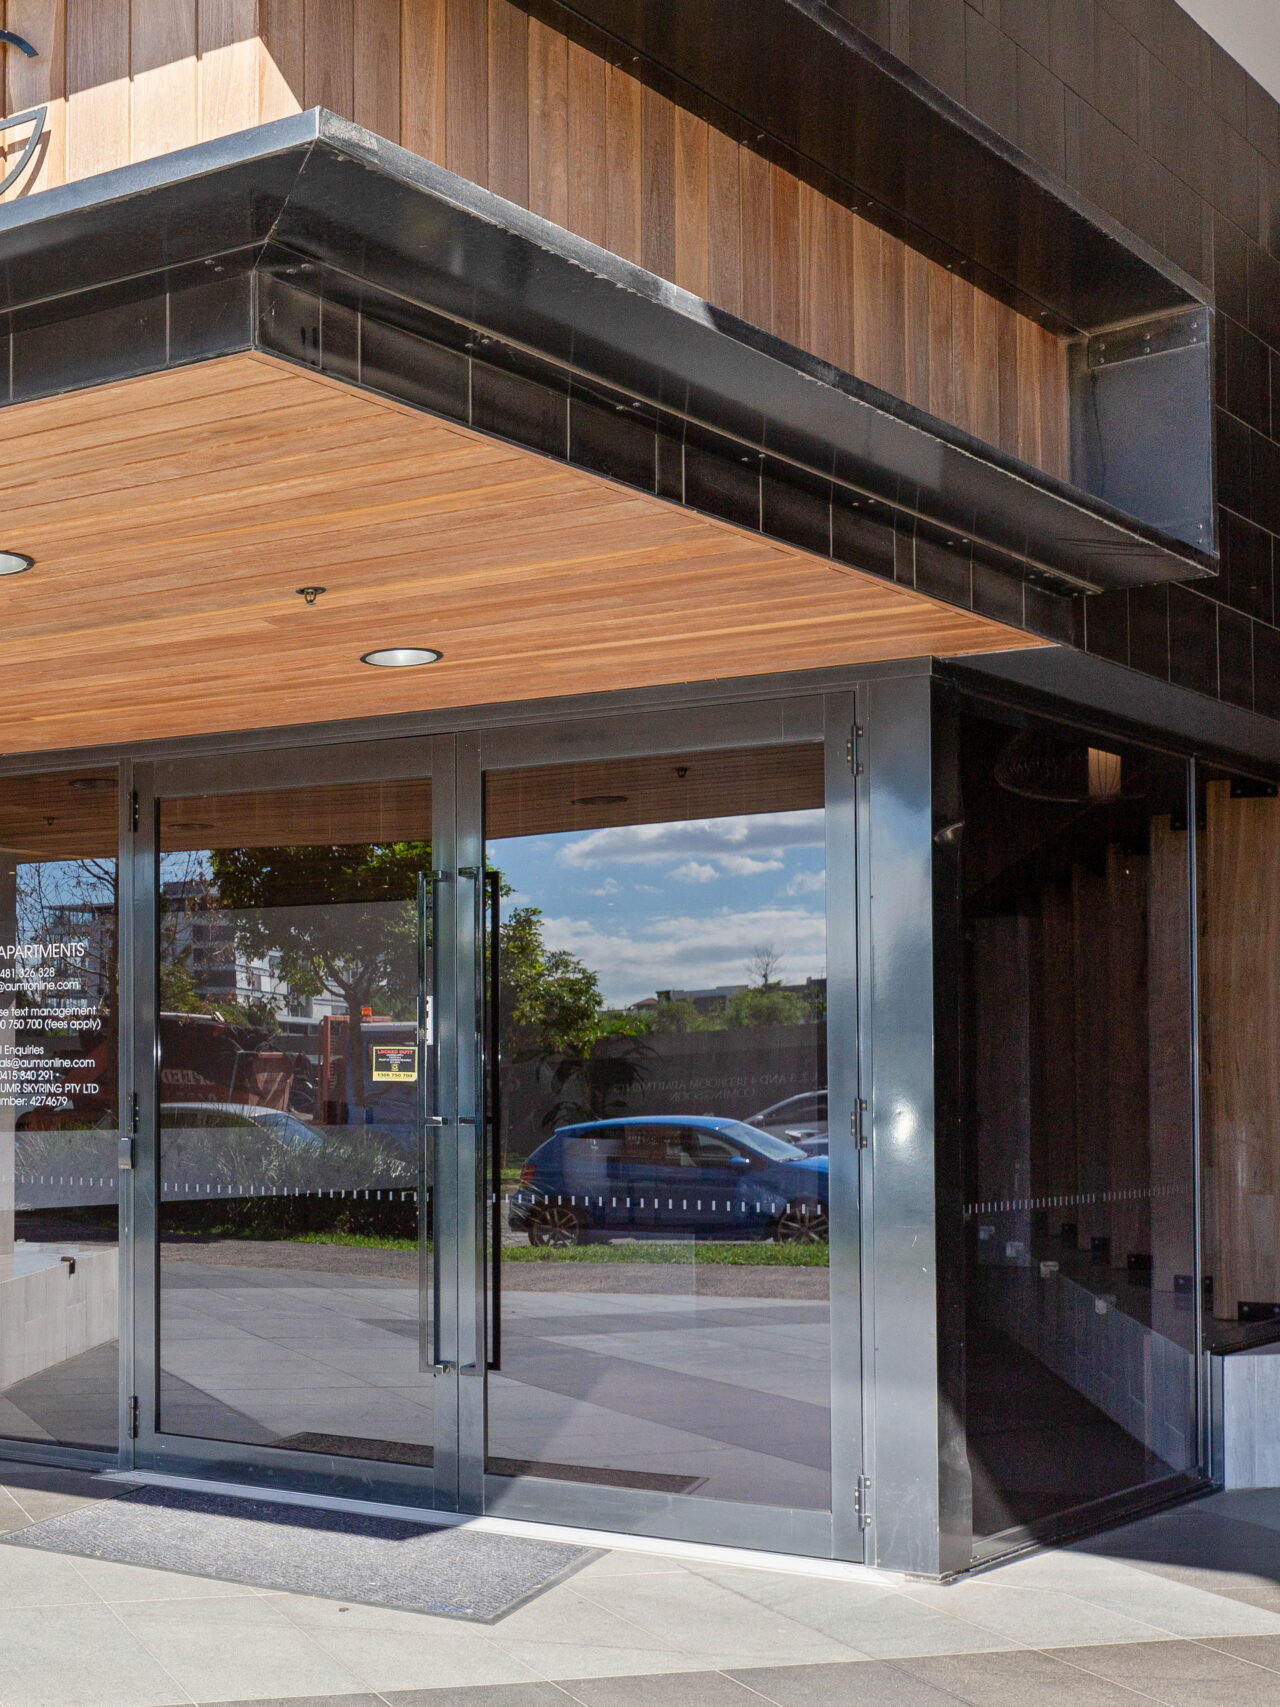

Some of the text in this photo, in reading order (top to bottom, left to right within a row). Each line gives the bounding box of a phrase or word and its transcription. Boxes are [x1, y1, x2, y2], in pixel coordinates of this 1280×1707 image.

[19, 968, 36, 978] 326
[38, 967, 55, 977] 328
[11, 1006, 29, 1017] text
[30, 1005, 96, 1018] management
[8, 1019, 24, 1029] 750
[26, 1019, 43, 1029] 700
[44, 1018, 68, 1031] (fees
[69, 1018, 101, 1031] apply)
[5, 1044, 44, 1057] Enquiries
[20, 1070, 36, 1080] 340
[38, 1070, 53, 1080] 291
[22, 1083, 63, 1093] SKYRING
[64, 1083, 81, 1093] PTY
[83, 1083, 99, 1094] LTD
[29, 1096, 68, 1106] 4274679
